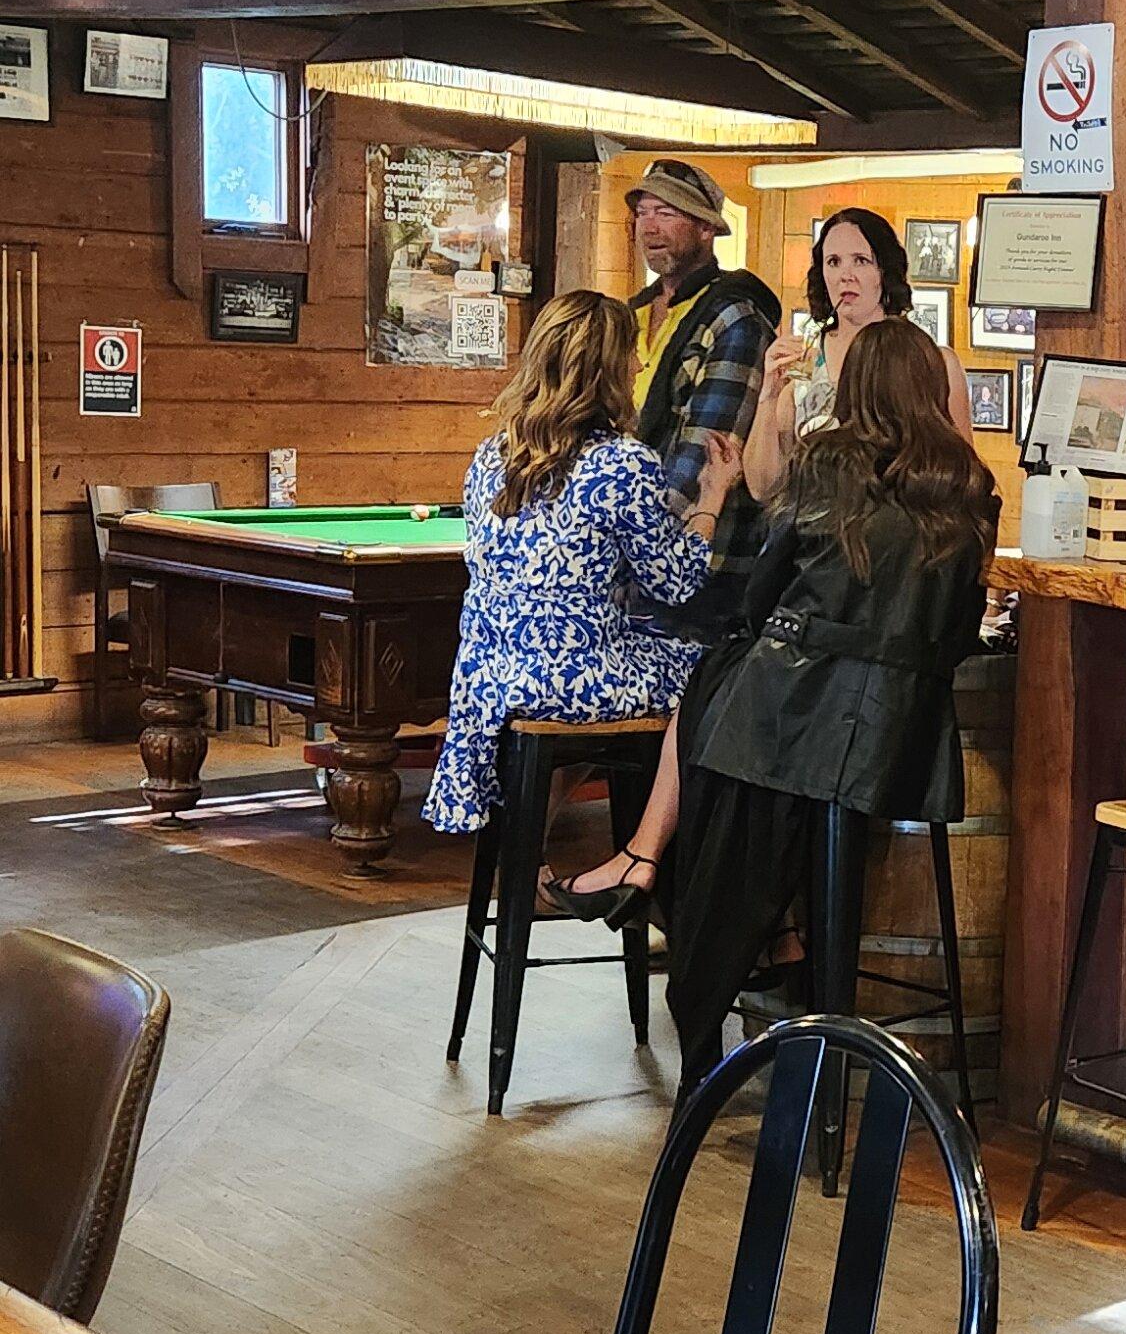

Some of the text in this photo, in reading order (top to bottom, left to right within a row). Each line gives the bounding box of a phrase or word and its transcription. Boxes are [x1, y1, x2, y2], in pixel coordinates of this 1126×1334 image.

[1050, 133, 1078, 152] NO
[384, 158, 428, 177] Looking
[448, 167, 462, 177] an
[1030, 158, 1104, 175] SMOKING
[384, 173, 416, 185] event
[450, 176, 473, 189] with
[384, 195, 395, 208] &
[398, 197, 433, 213] plenty
[384, 208, 395, 220] to
[1016, 233, 1062, 242] Gundaroo Inn
[459, 276, 479, 285] SCAN
